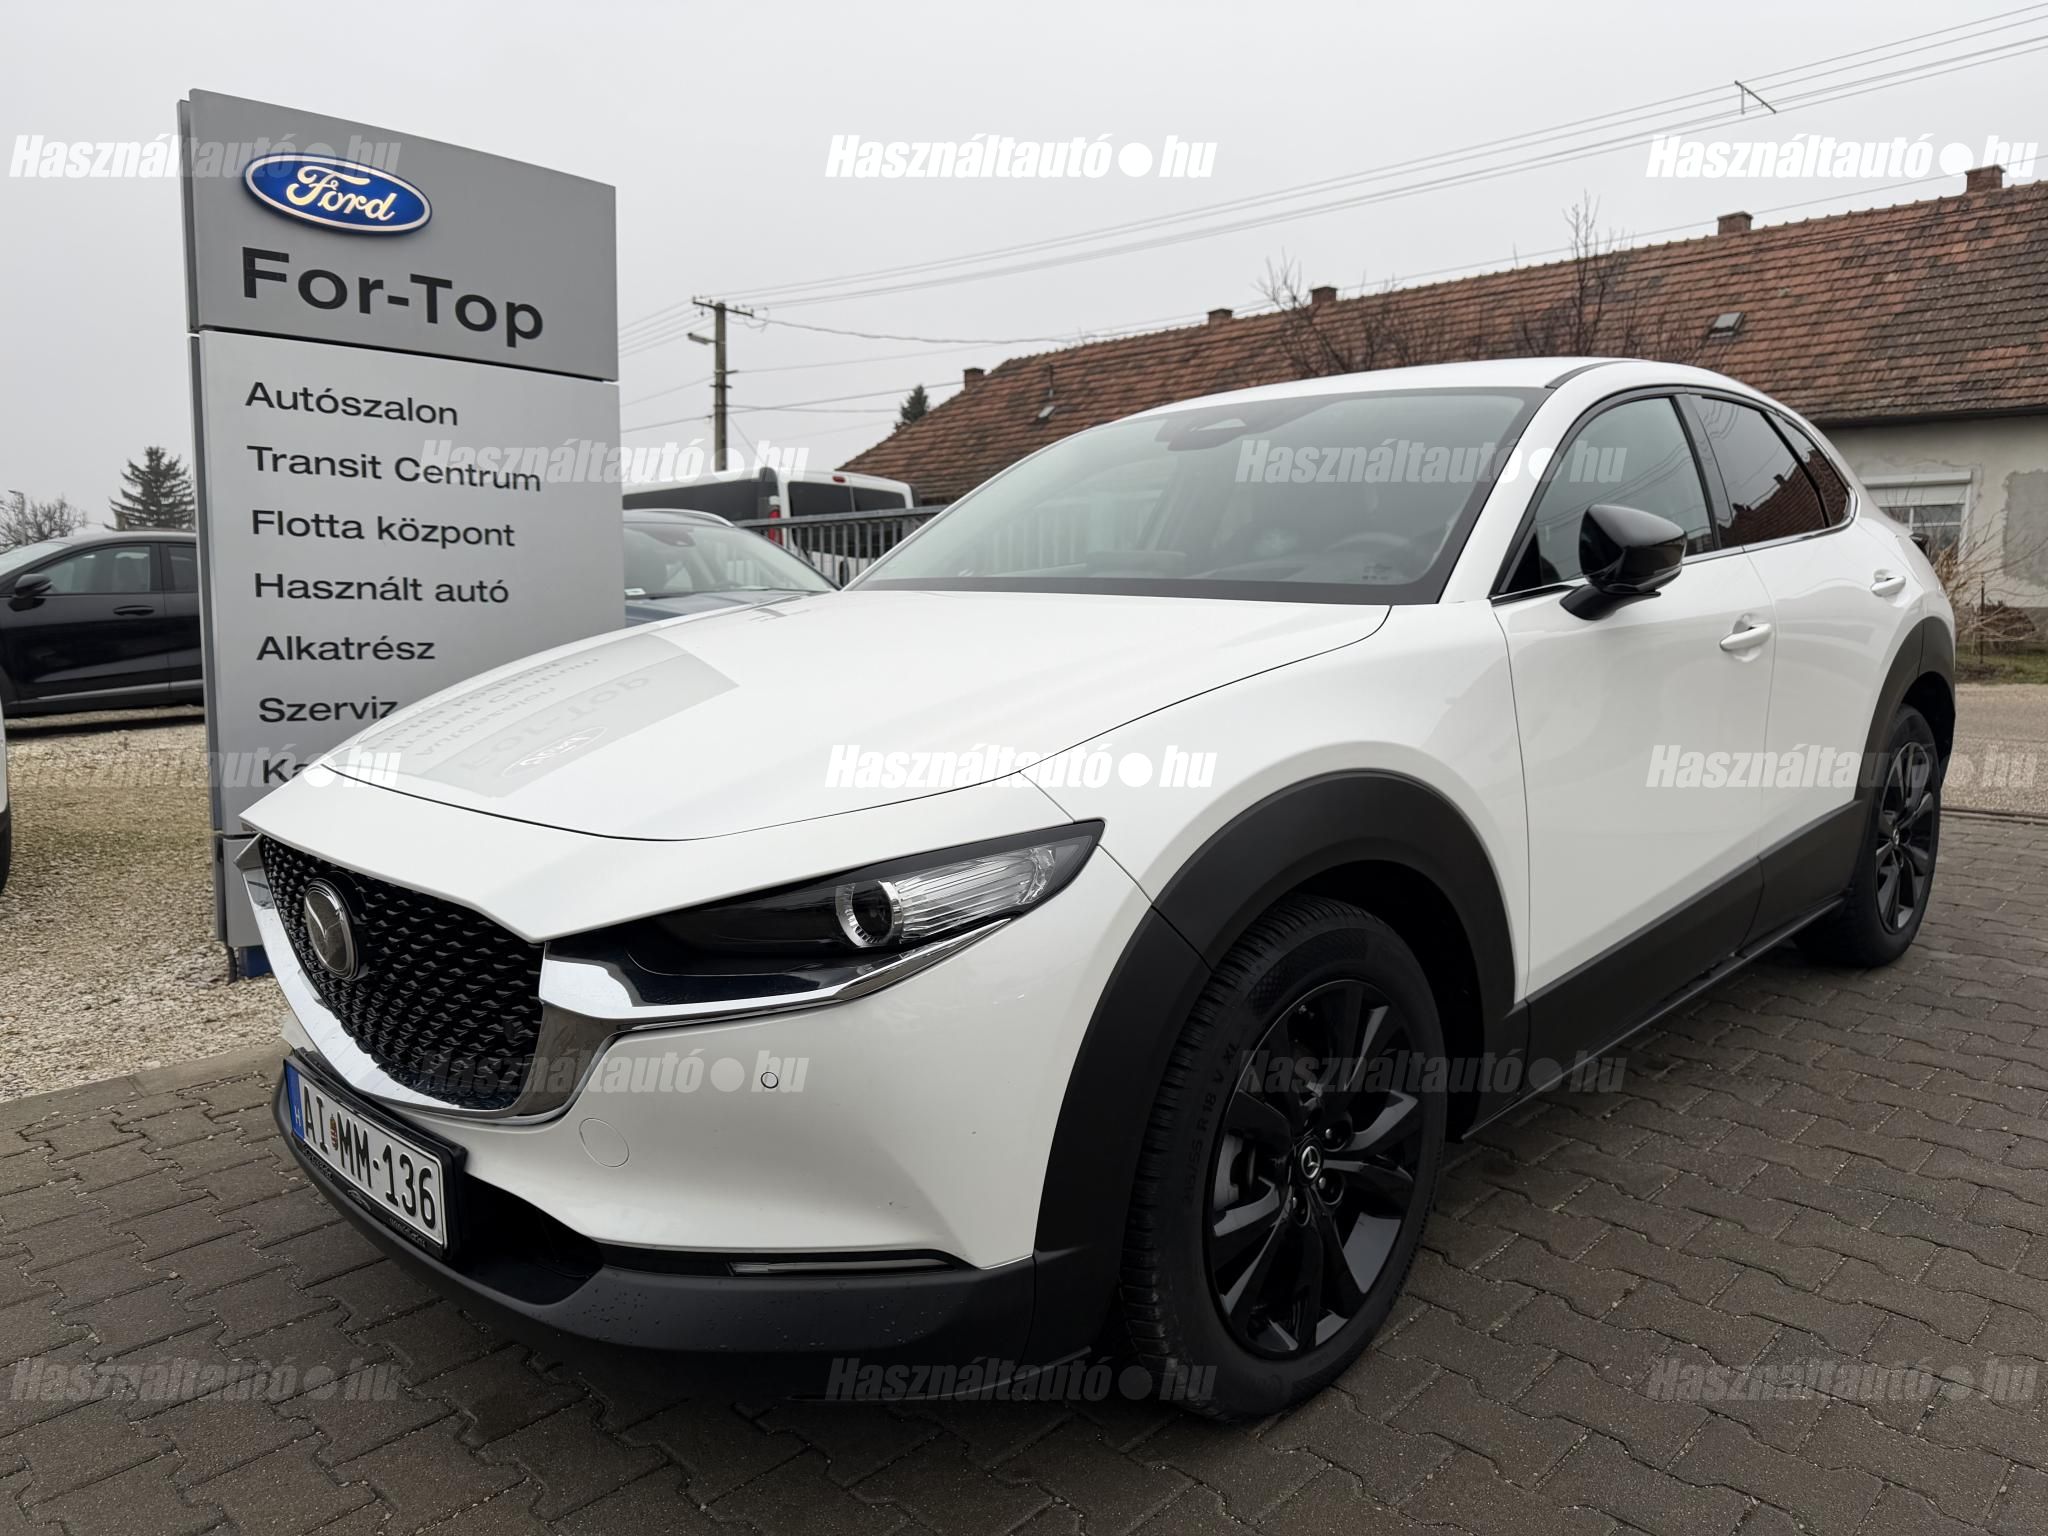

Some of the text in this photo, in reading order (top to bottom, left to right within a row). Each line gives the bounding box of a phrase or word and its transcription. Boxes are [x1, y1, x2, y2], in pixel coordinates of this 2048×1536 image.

[286, 164, 399, 222] Ford
[242, 246, 544, 348] For-Top
[245, 382, 459, 426] Autószalon
[247, 445, 541, 492] Transit Centrum
[252, 509, 516, 549] Flotta központ
[254, 573, 510, 603] Használt autó
[256, 635, 436, 661] Alkatrész
[259, 696, 399, 723] Szerviz
